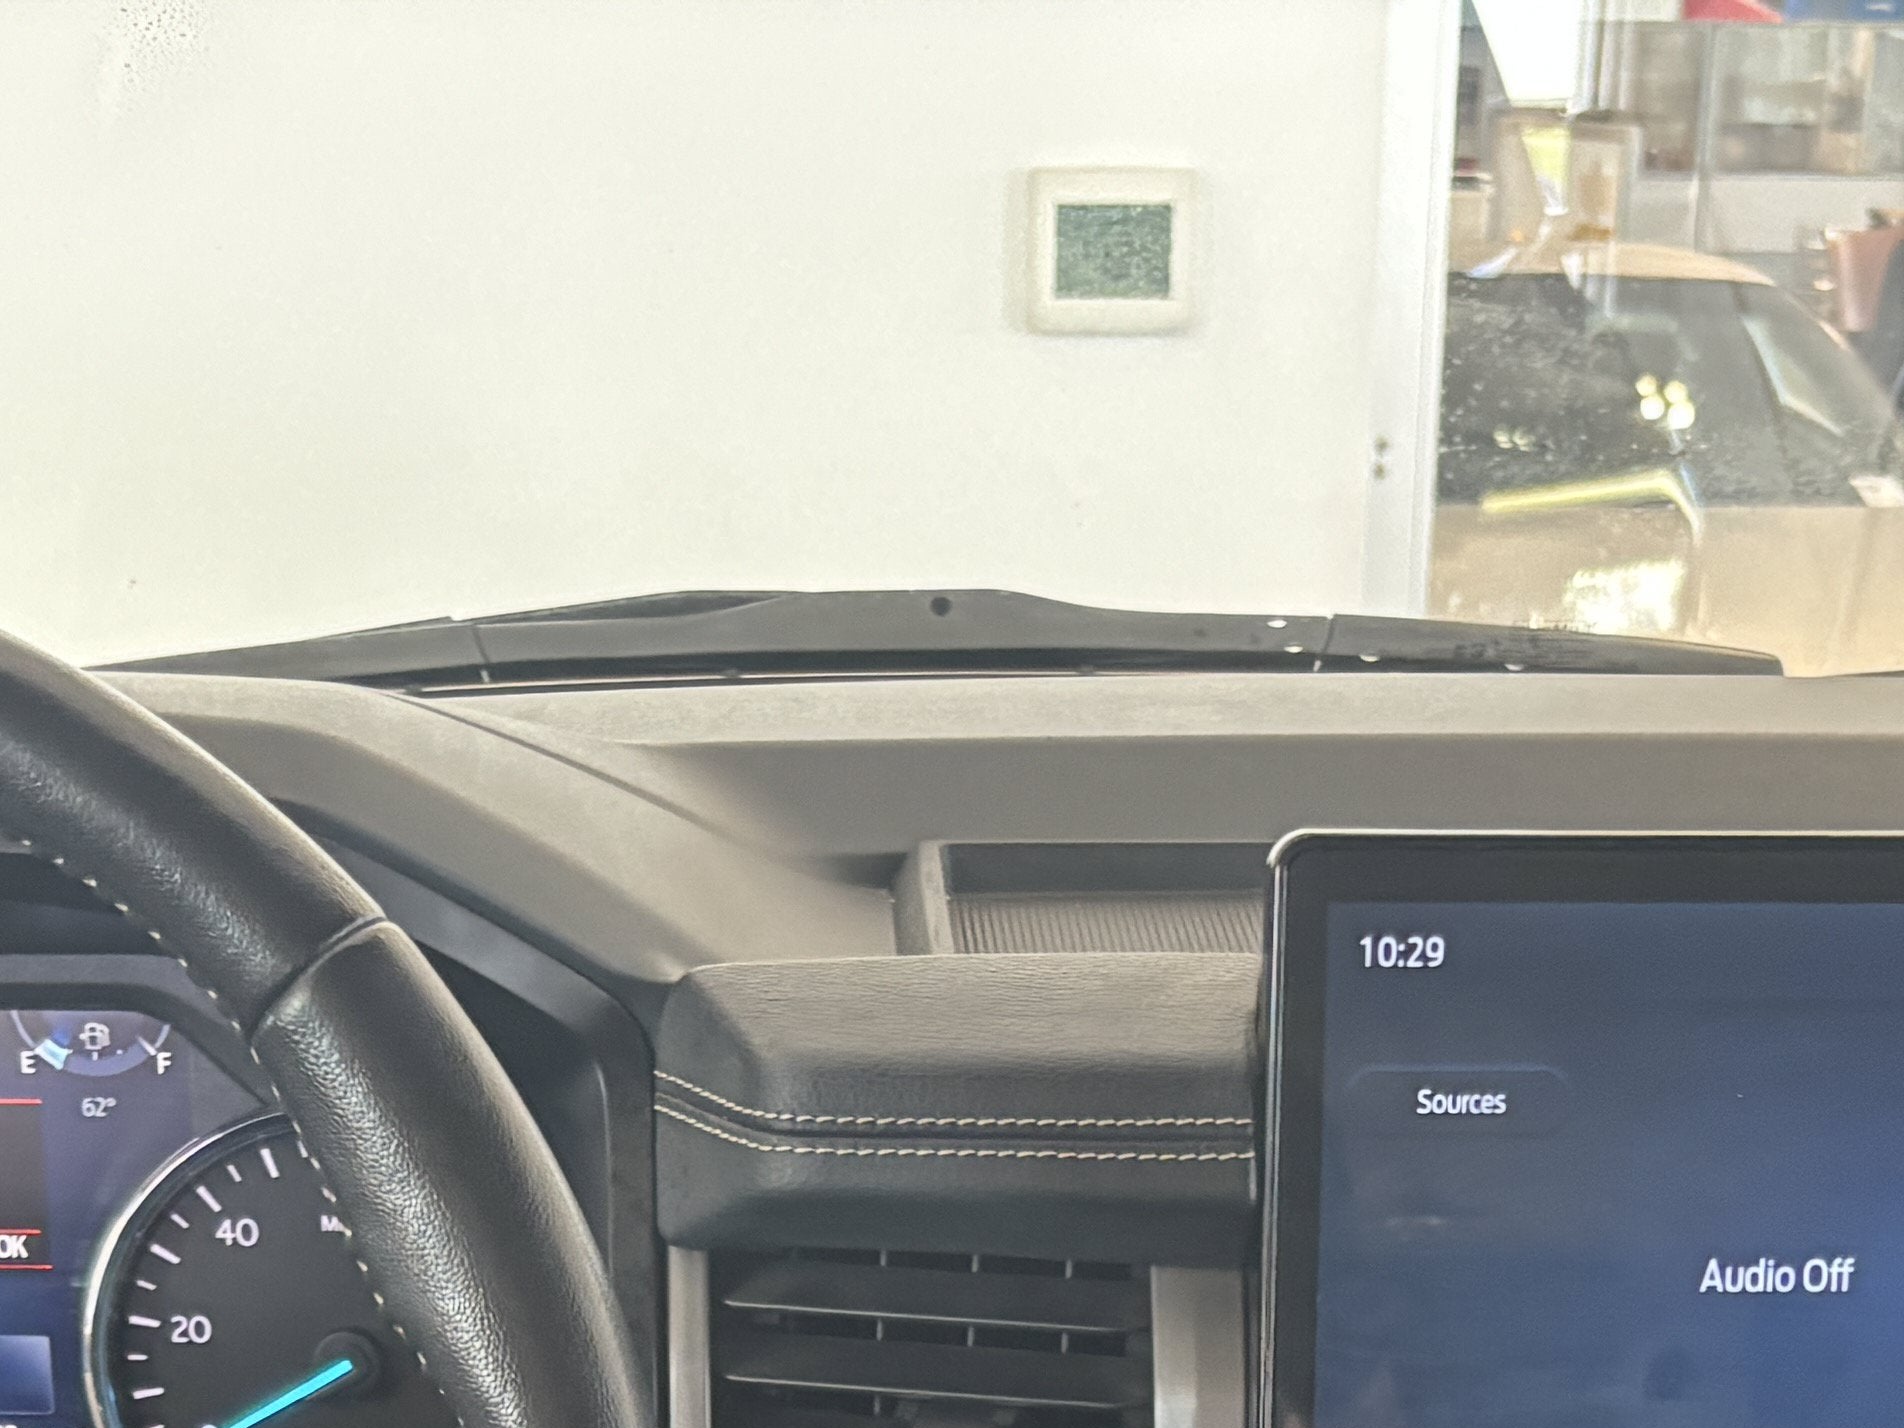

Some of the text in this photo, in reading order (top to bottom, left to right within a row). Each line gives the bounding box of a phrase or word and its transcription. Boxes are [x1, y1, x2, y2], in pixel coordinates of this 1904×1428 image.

[1358, 934, 1445, 969] 10:29
[21, 1052, 36, 1074] E
[157, 1051, 172, 1074] F
[81, 1097, 117, 1118] 62°
[1415, 1088, 1507, 1116] Sources
[214, 1218, 260, 1248] 40
[1698, 1257, 1856, 1294] Audio Off
[170, 1315, 213, 1344] 20
